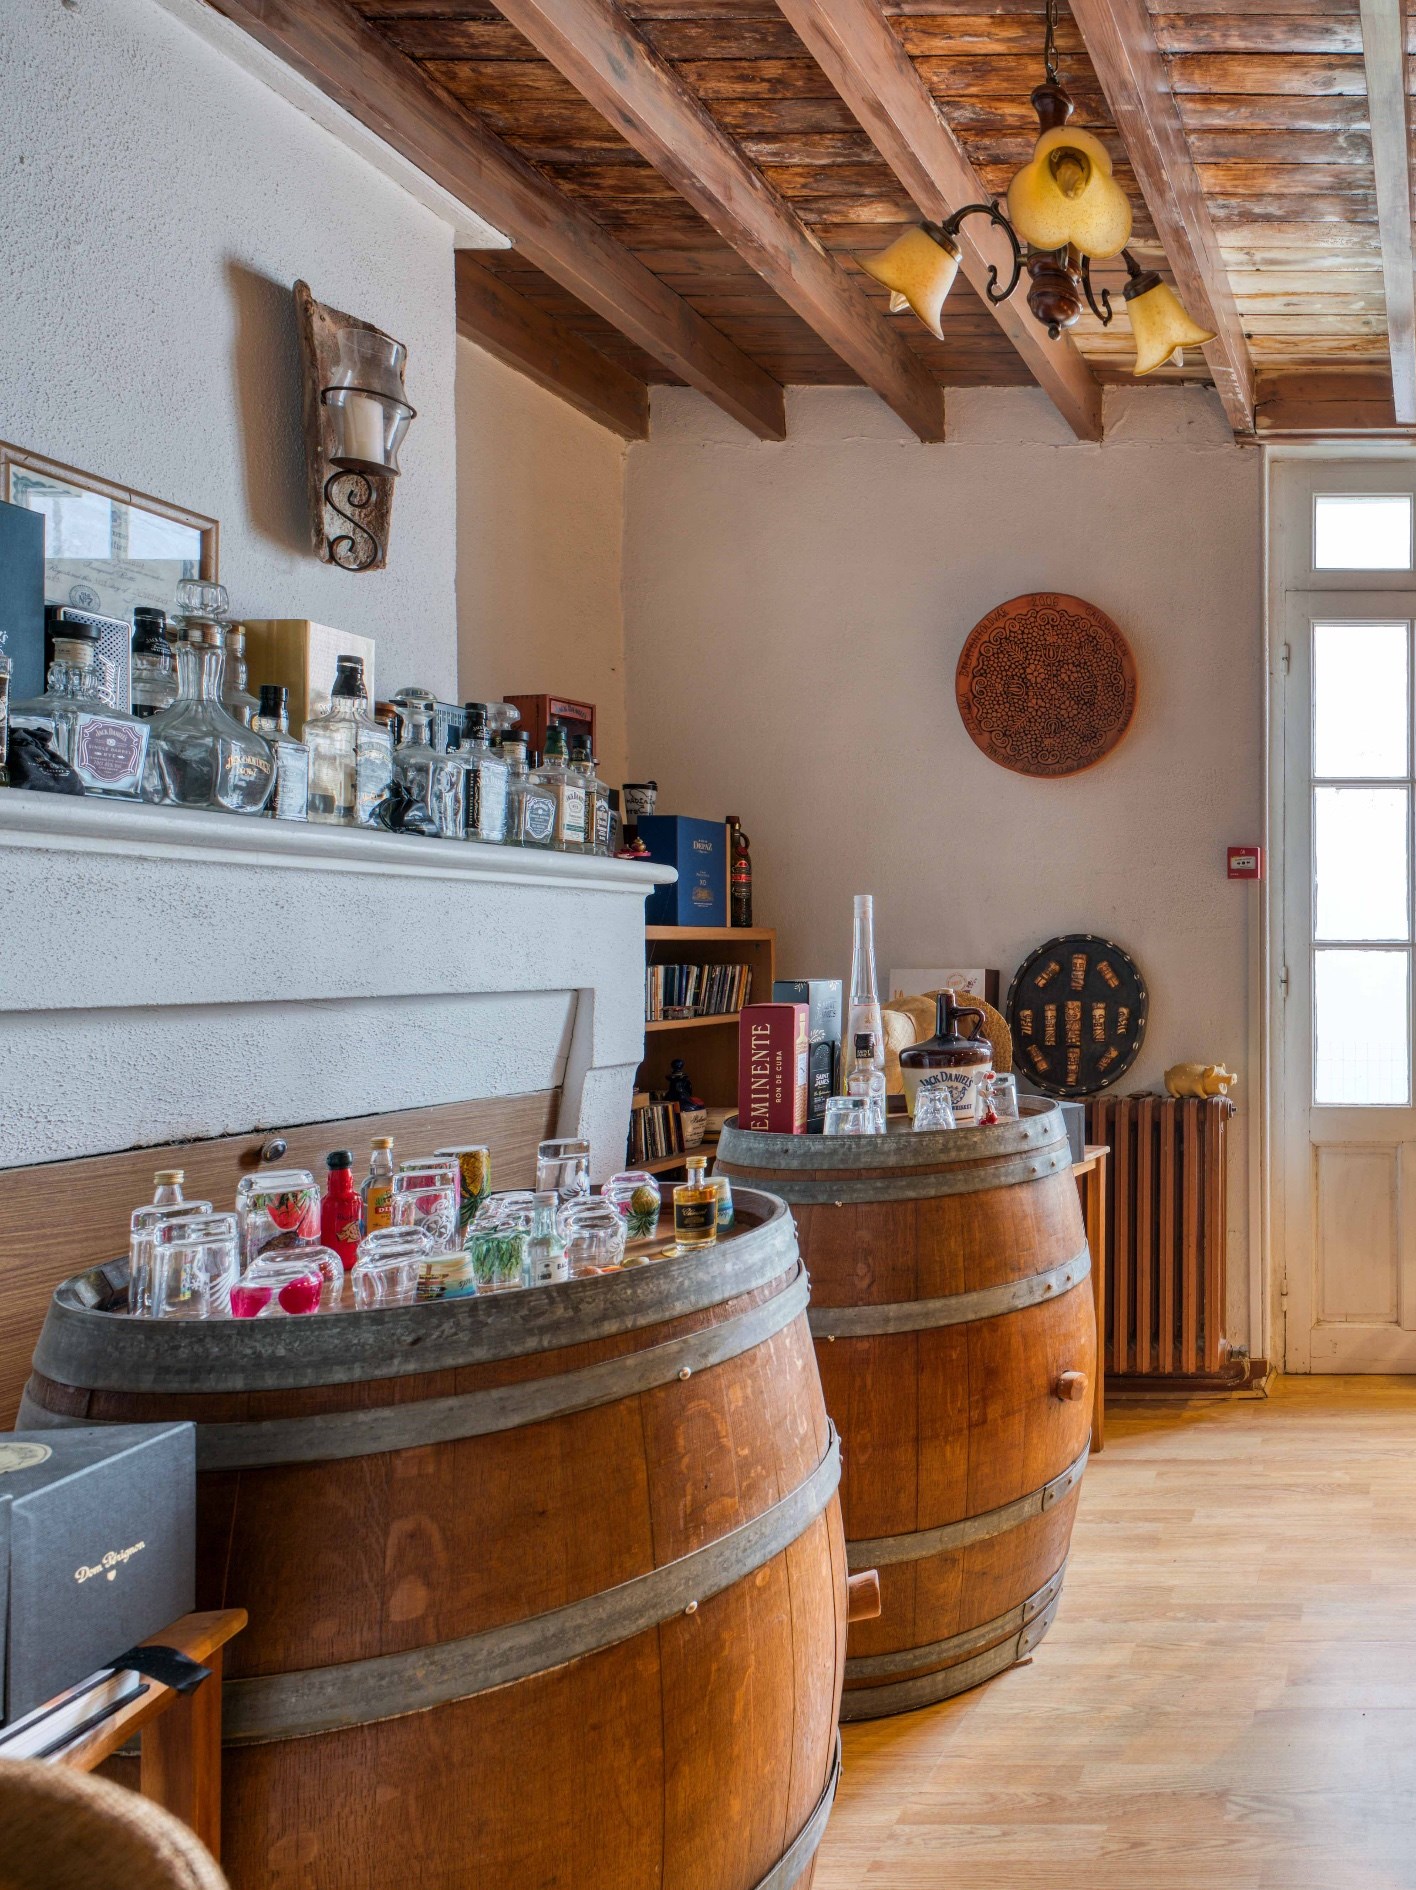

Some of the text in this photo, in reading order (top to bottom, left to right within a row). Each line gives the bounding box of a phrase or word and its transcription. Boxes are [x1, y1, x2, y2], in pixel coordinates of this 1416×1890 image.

[95, 728, 128, 742] JACK DANIEL'S
[693, 840, 713, 851] DEPAZ
[751, 1023, 771, 1131] EMINENTE
[775, 1050, 783, 1103] RON DE CUBA
[814, 1079, 830, 1087] JAMES
[815, 1073, 830, 1081] SAINT
[920, 1071, 974, 1088] JACK DANIEL'S
[74, 1540, 146, 1583] Dom Pérignon
